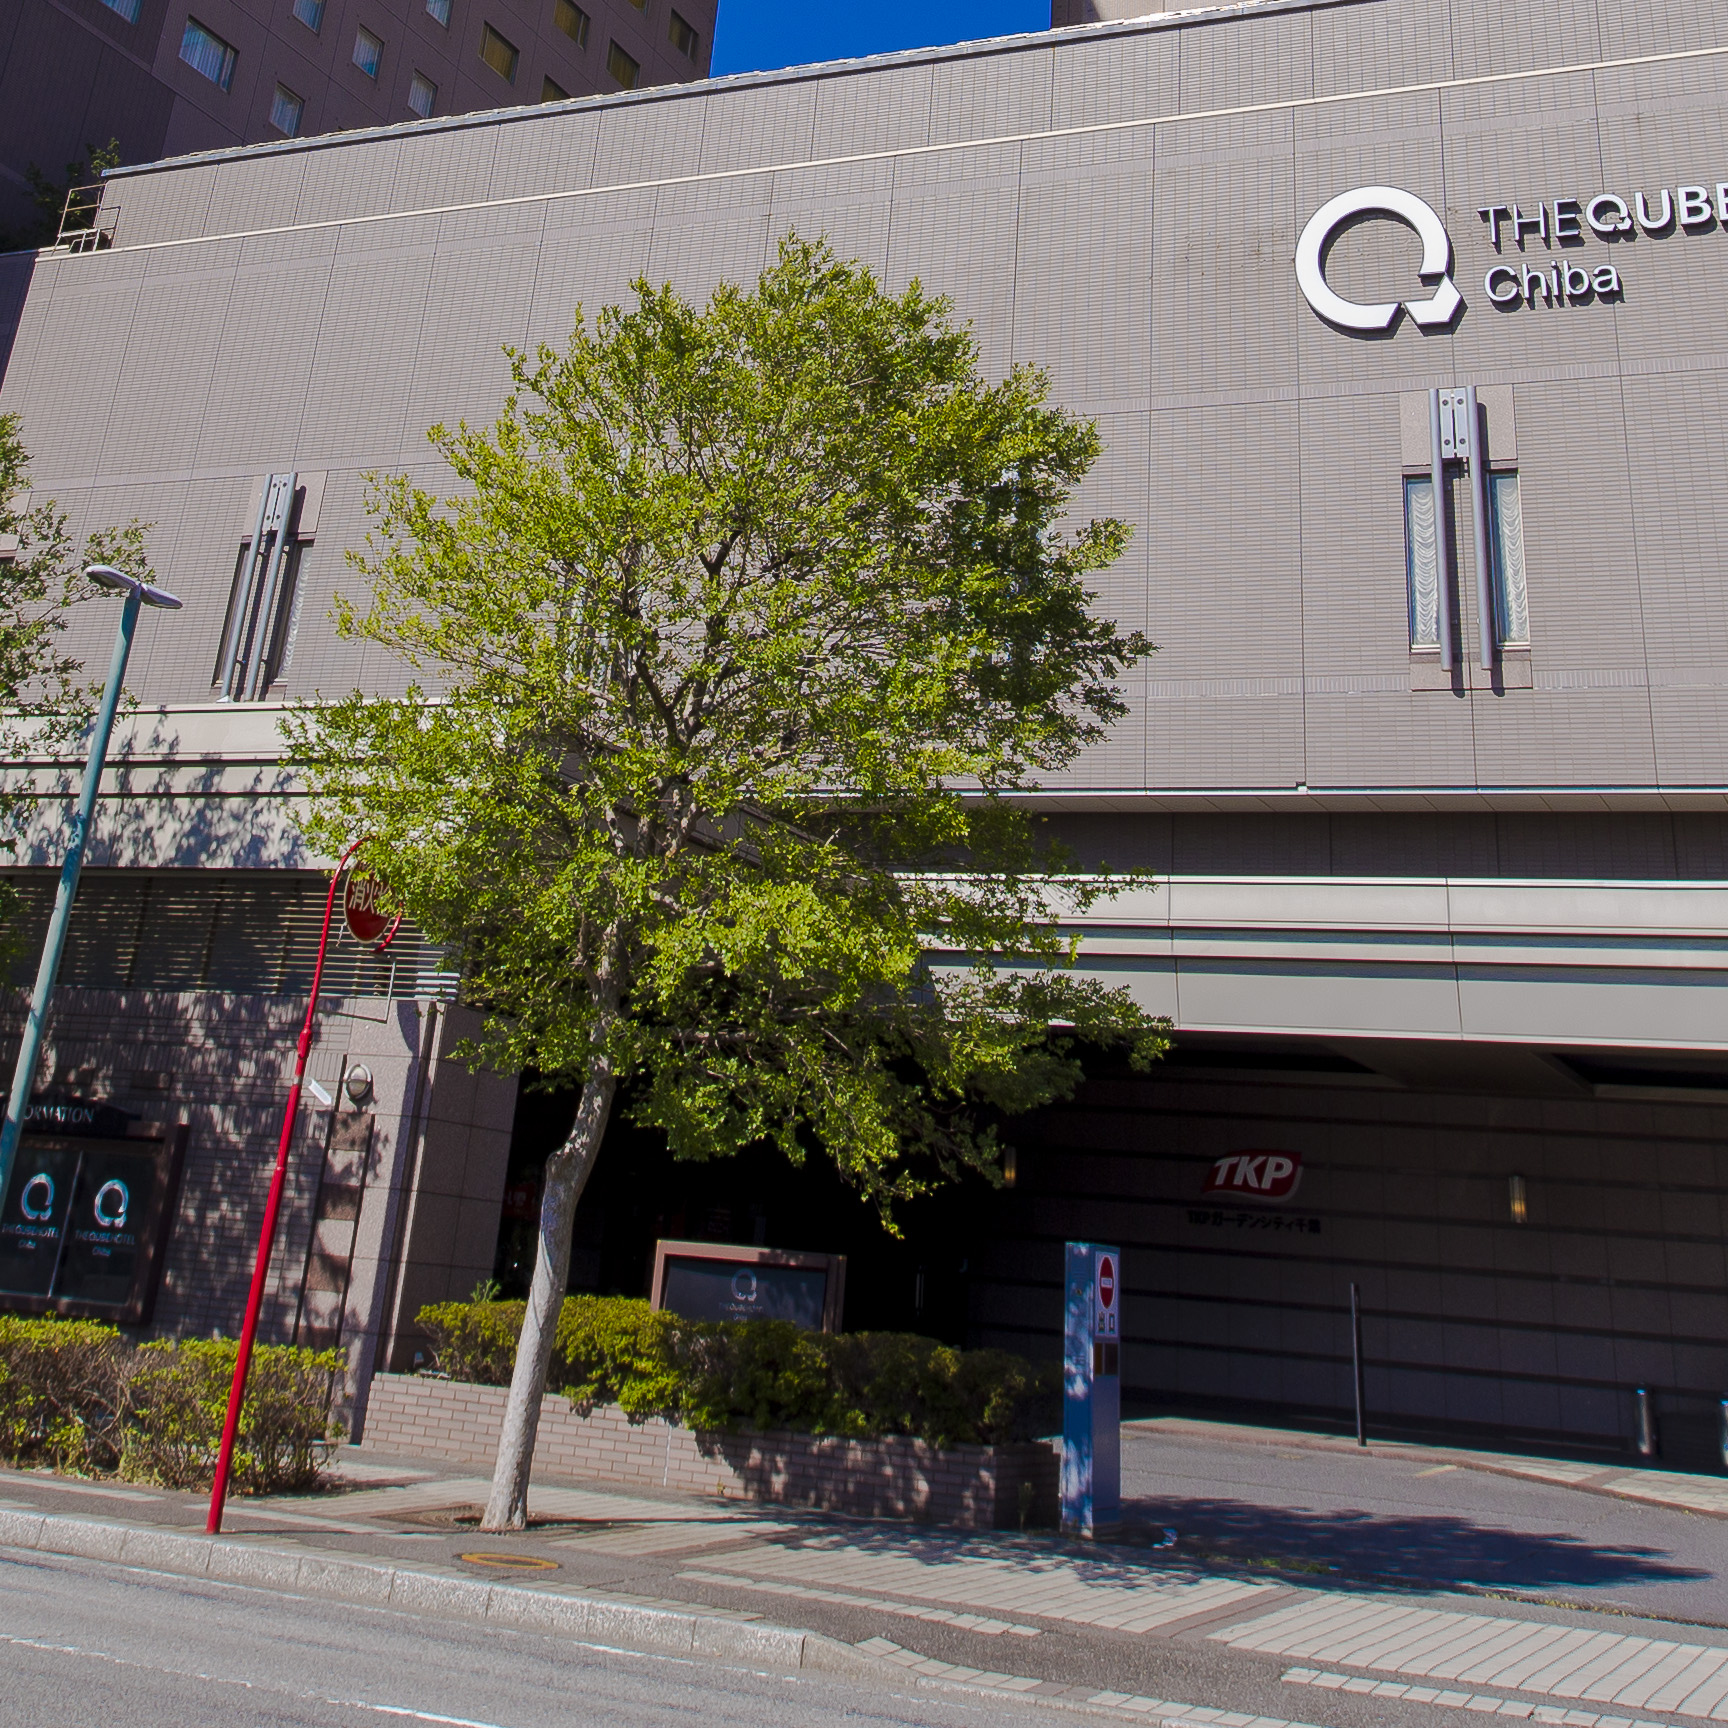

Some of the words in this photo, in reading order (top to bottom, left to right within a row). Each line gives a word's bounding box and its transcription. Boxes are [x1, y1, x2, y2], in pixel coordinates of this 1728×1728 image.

[1483, 259, 1621, 303] Chiba
[348, 878, 391, 918] 消火
[1, 1104, 95, 1123] IORMATION
[1213, 1154, 1294, 1190] TKP
